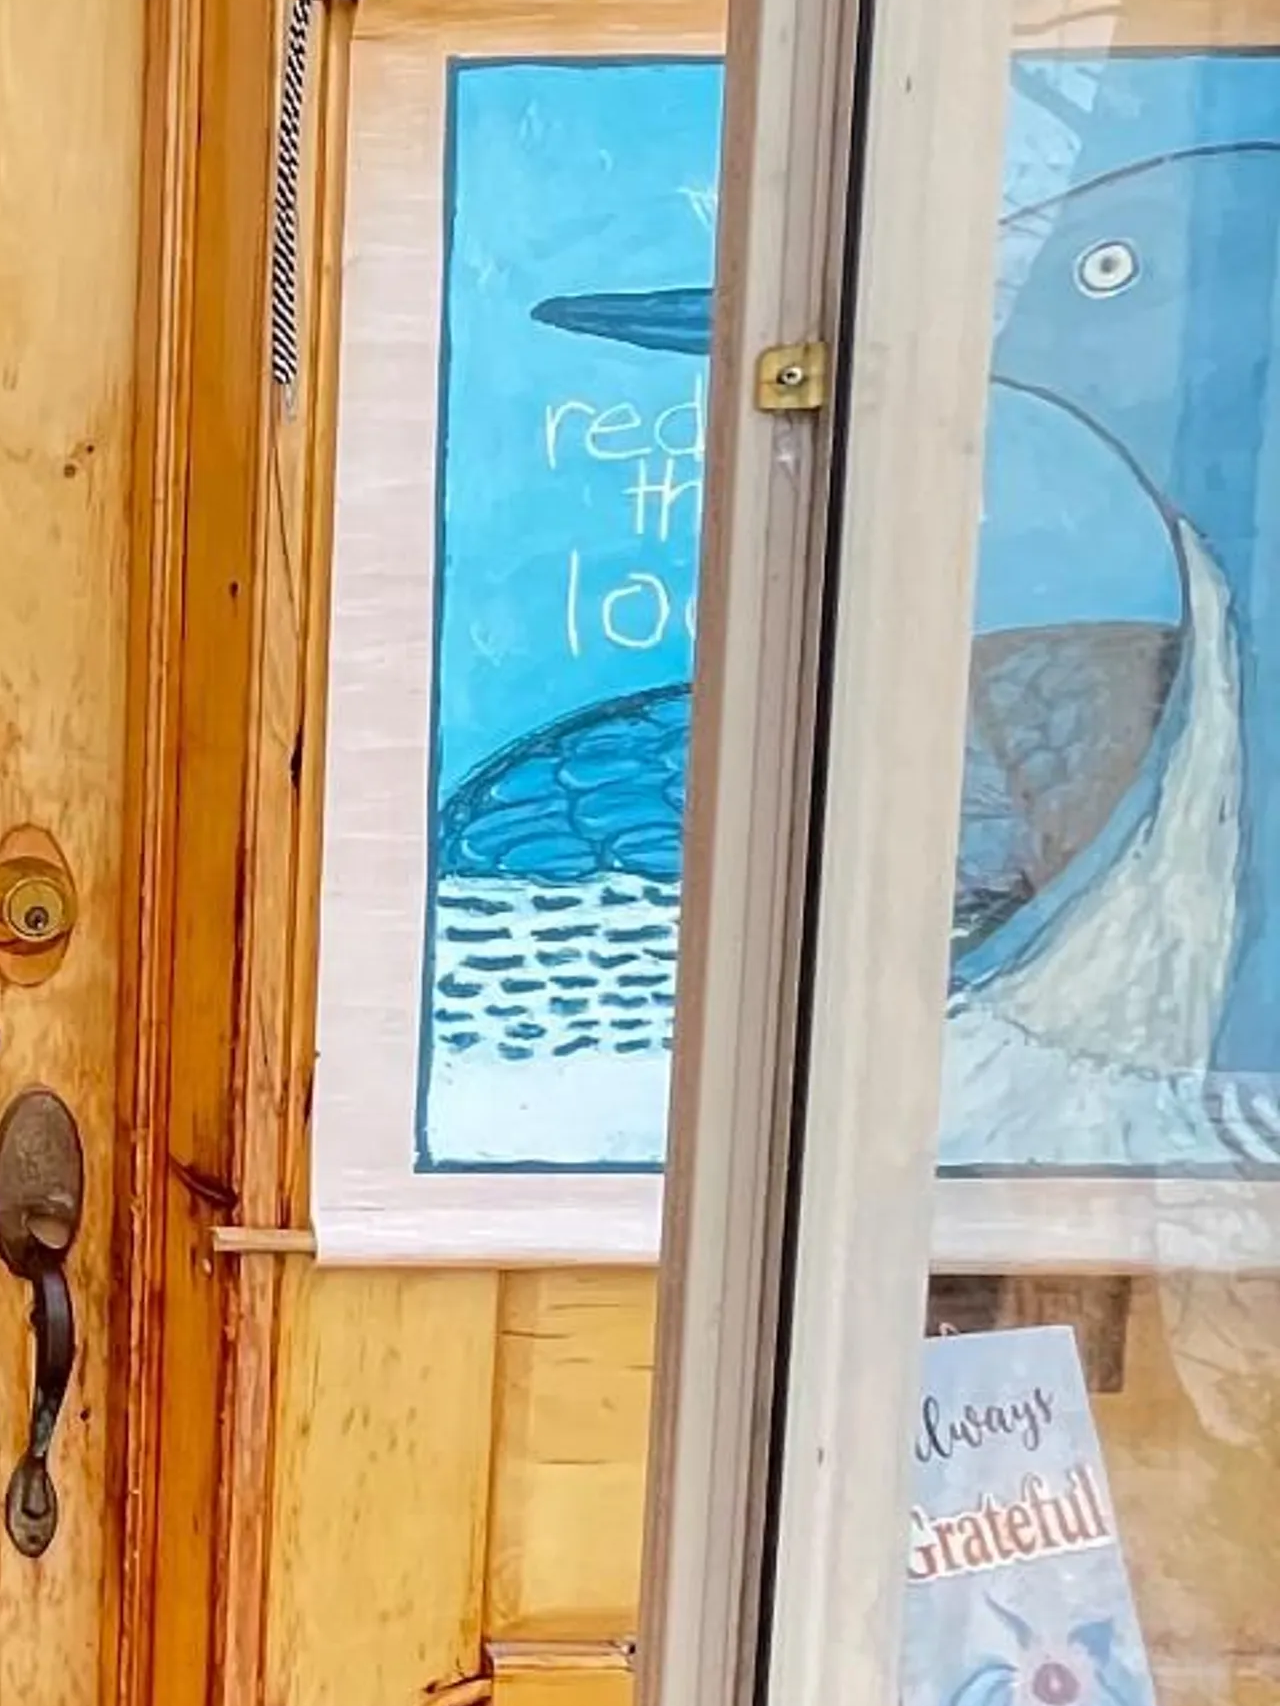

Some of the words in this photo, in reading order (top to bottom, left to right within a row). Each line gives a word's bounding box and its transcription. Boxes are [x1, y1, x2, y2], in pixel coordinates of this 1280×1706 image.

[622, 458, 702, 541] th
[567, 549, 697, 658] lo
[915, 1388, 1053, 1462] lways
